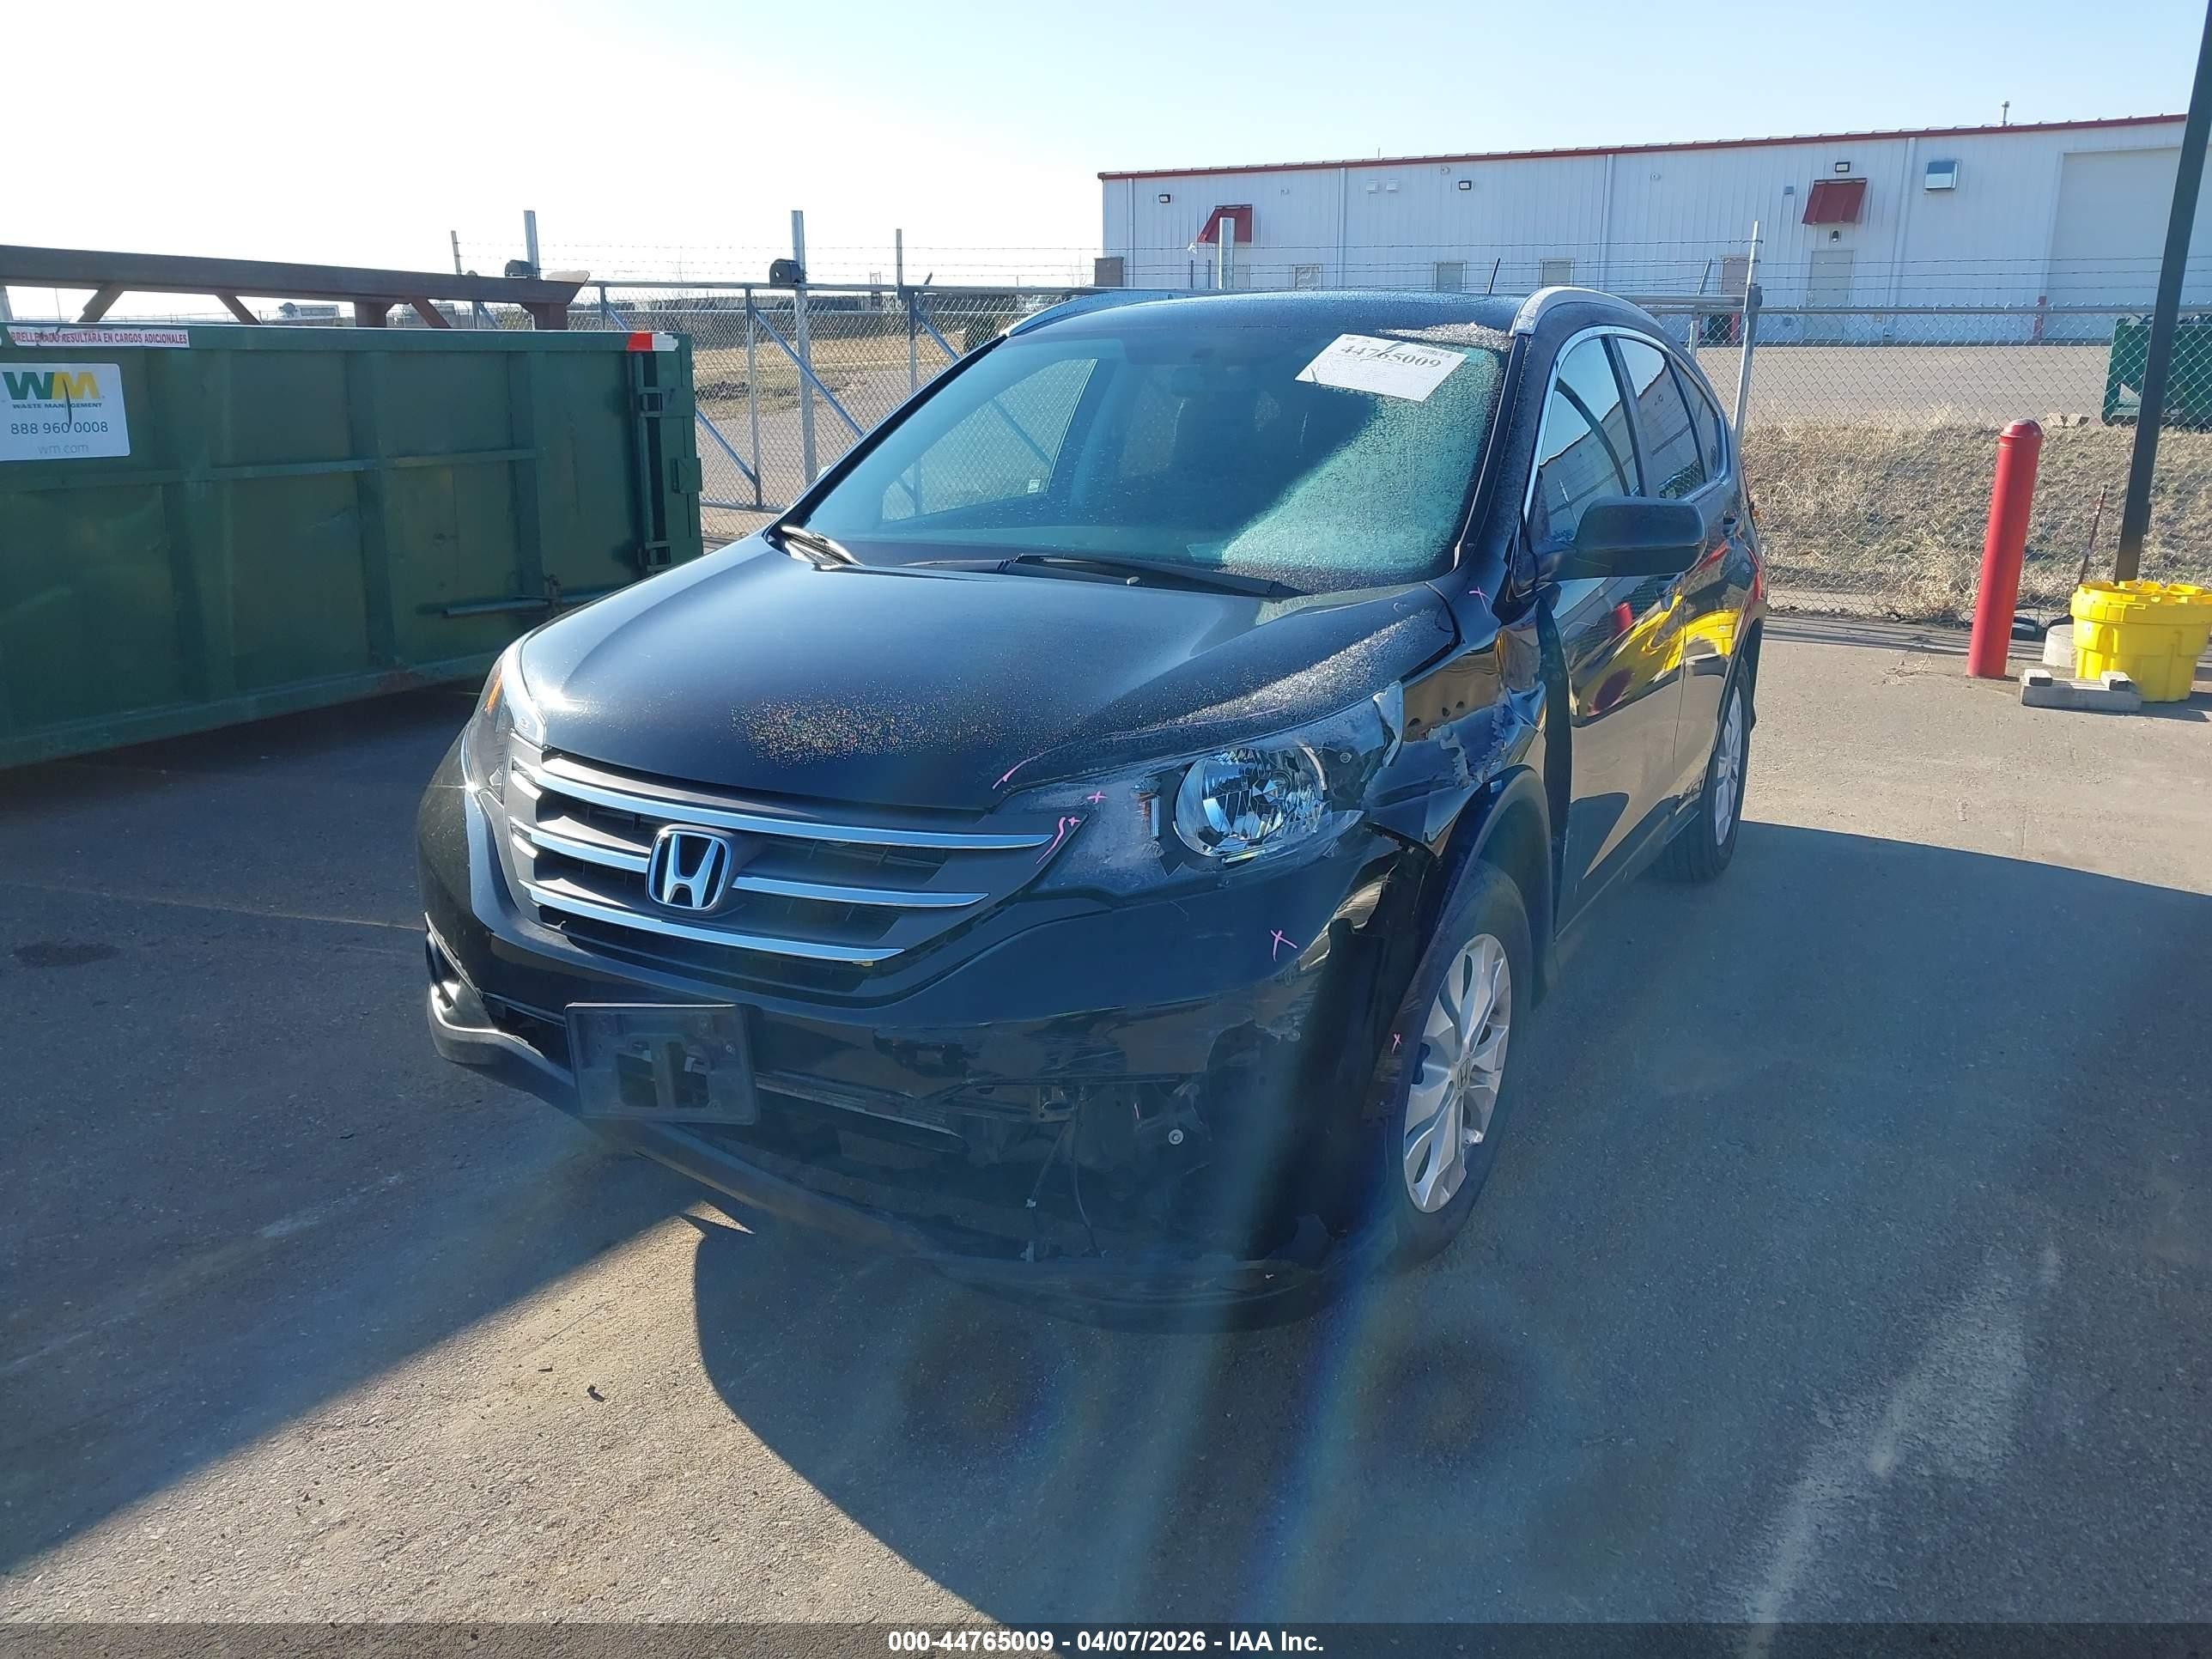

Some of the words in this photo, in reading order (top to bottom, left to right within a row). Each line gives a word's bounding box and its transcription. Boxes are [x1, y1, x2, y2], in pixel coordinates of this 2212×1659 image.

[104, 333, 113, 343] EN
[114, 333, 143, 343] CARGOS
[144, 334, 187, 344] ADICIONALES
[2, 371, 100, 400] WM
[10, 422, 39, 434] 888
[43, 422, 70, 434] 960
[74, 422, 108, 433] 0008
[37, 444, 89, 454] wm.com
